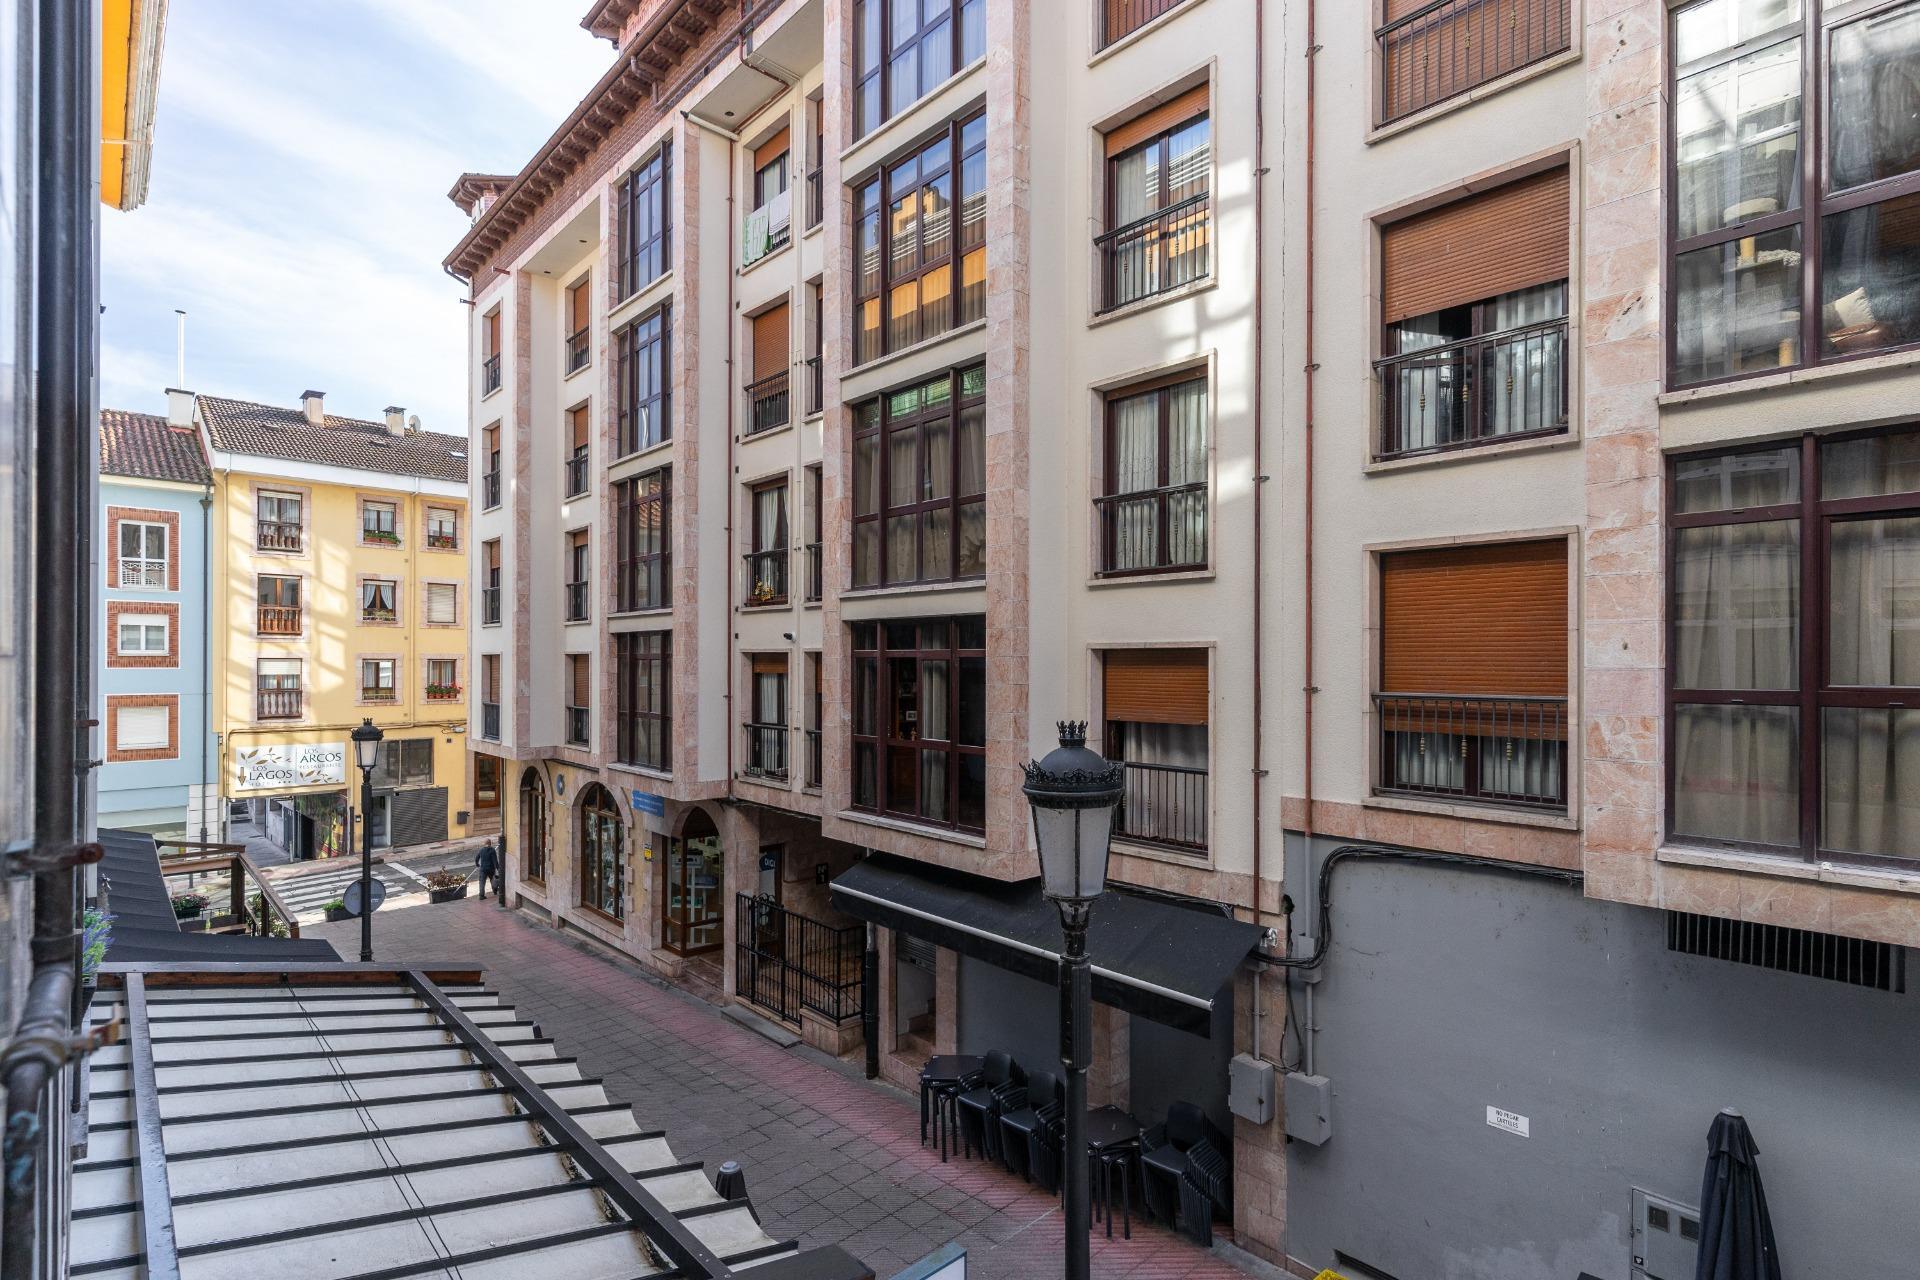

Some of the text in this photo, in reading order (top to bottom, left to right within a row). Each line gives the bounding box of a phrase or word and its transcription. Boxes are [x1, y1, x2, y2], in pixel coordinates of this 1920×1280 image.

[299, 752, 342, 764] ARCOS
[249, 769, 293, 781] LAGOS
[1495, 1109, 1503, 1117] NO
